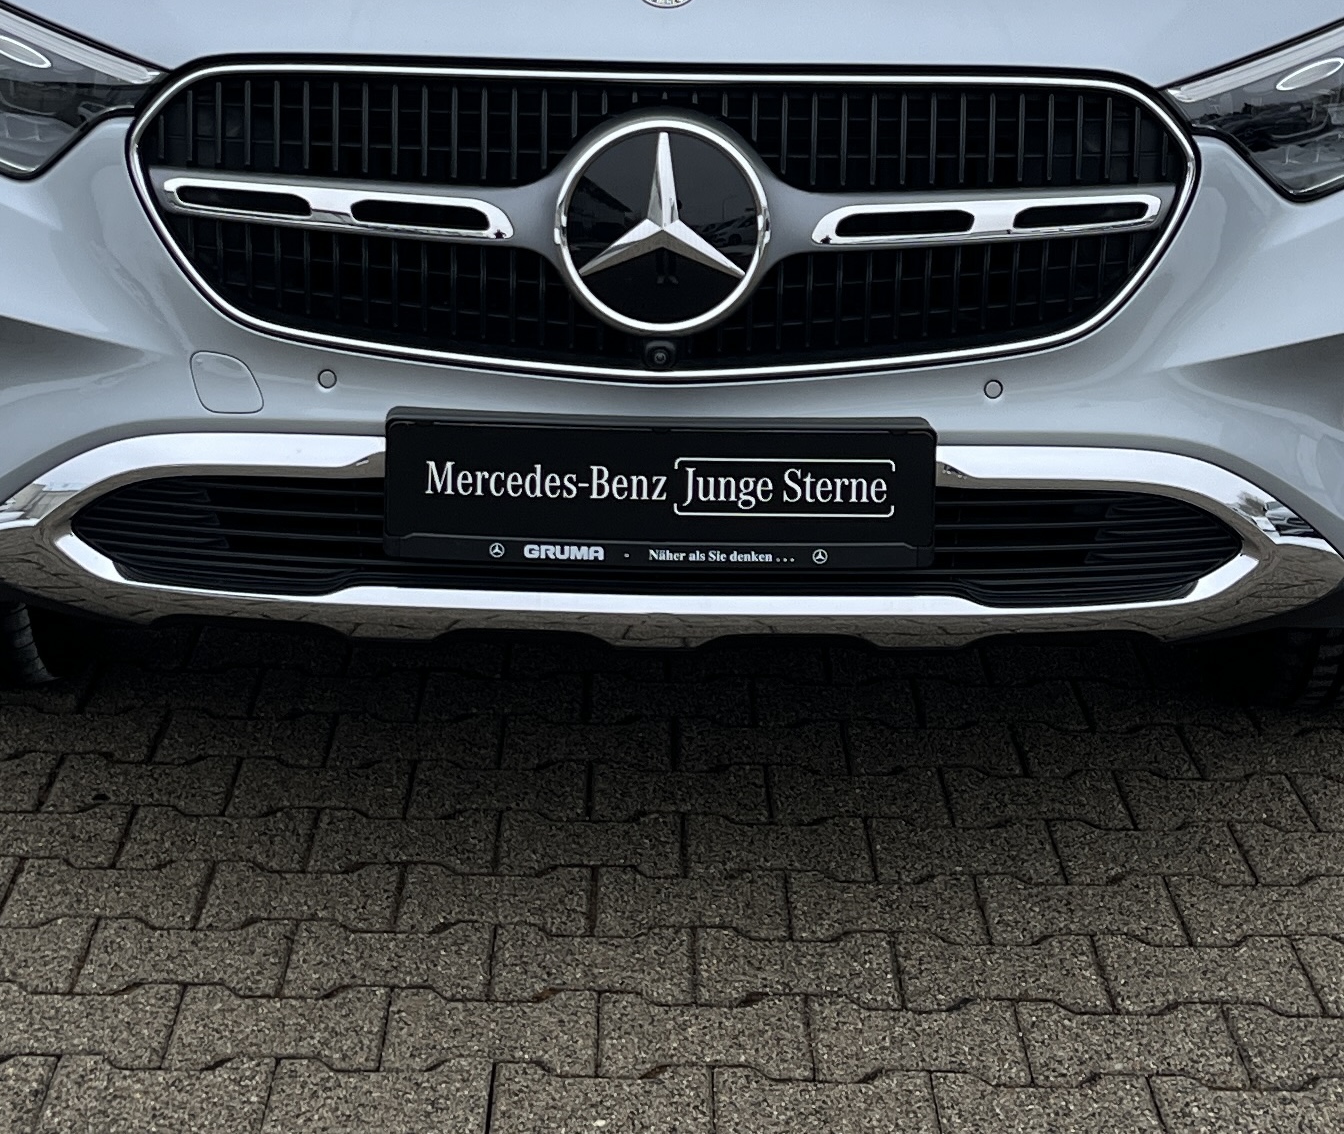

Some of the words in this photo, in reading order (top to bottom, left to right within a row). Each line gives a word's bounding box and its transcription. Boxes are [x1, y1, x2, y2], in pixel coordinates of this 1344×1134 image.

[424, 460, 668, 501] Mercedes-Benz
[682, 466, 774, 510] Junge
[783, 468, 888, 504] Sterne
[523, 544, 605, 561] GRUMA
[648, 548, 686, 562] Näher
[688, 549, 706, 562] als
[707, 549, 727, 563] Sie
[729, 550, 773, 563] denken
